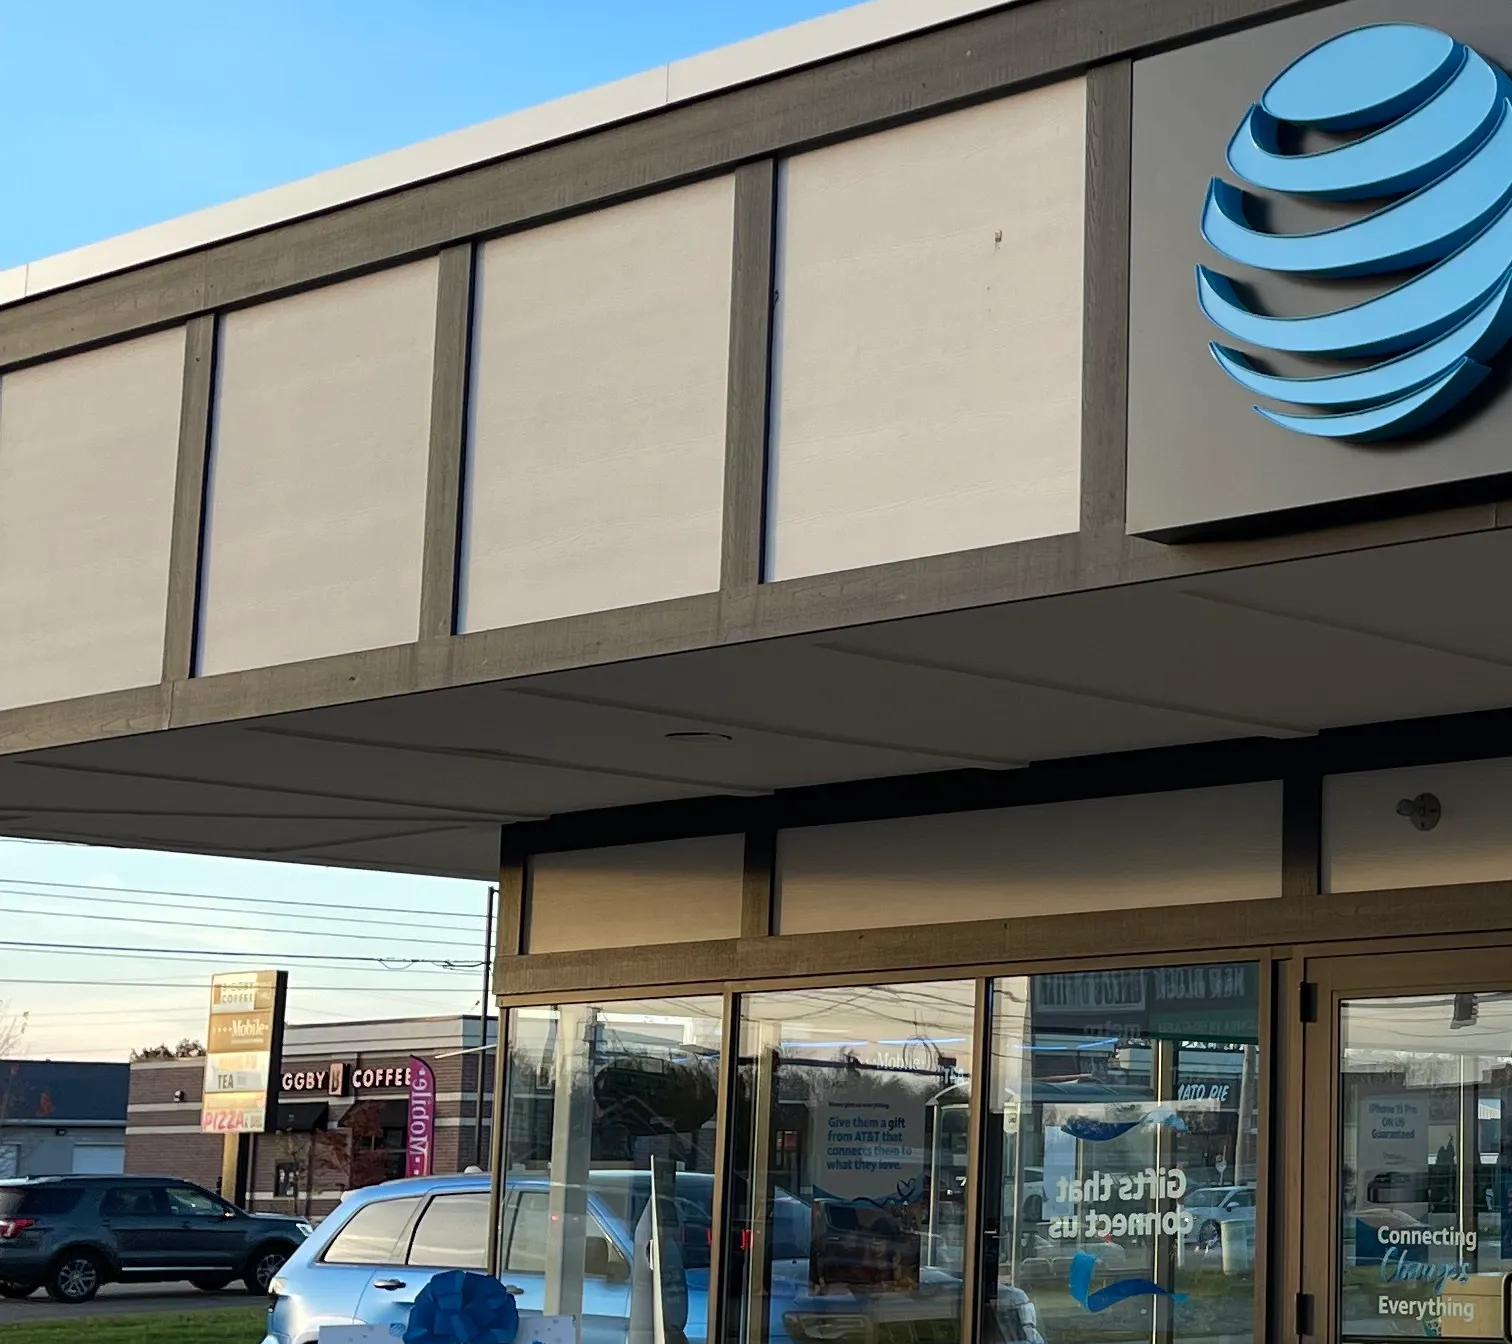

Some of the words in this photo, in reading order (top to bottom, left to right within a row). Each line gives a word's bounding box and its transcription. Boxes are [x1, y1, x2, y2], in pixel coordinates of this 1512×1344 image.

[282, 1070, 326, 1091] GGBY
[352, 1067, 411, 1088] COFFEE
[202, 1110, 244, 1131] PIZZA
[828, 1116, 850, 1128] Give
[853, 1116, 878, 1128] them
[880, 1119, 887, 1128] a
[888, 1117, 906, 1131] gift
[827, 1130, 853, 1141] from
[854, 1131, 880, 1141] AT&T
[882, 1130, 903, 1141] that
[827, 1158, 852, 1170] what
[854, 1158, 877, 1172] they
[1377, 1225, 1478, 1252] Connecting
[1380, 1246, 1472, 1294] Changes
[1378, 1295, 1475, 1323] Everything
